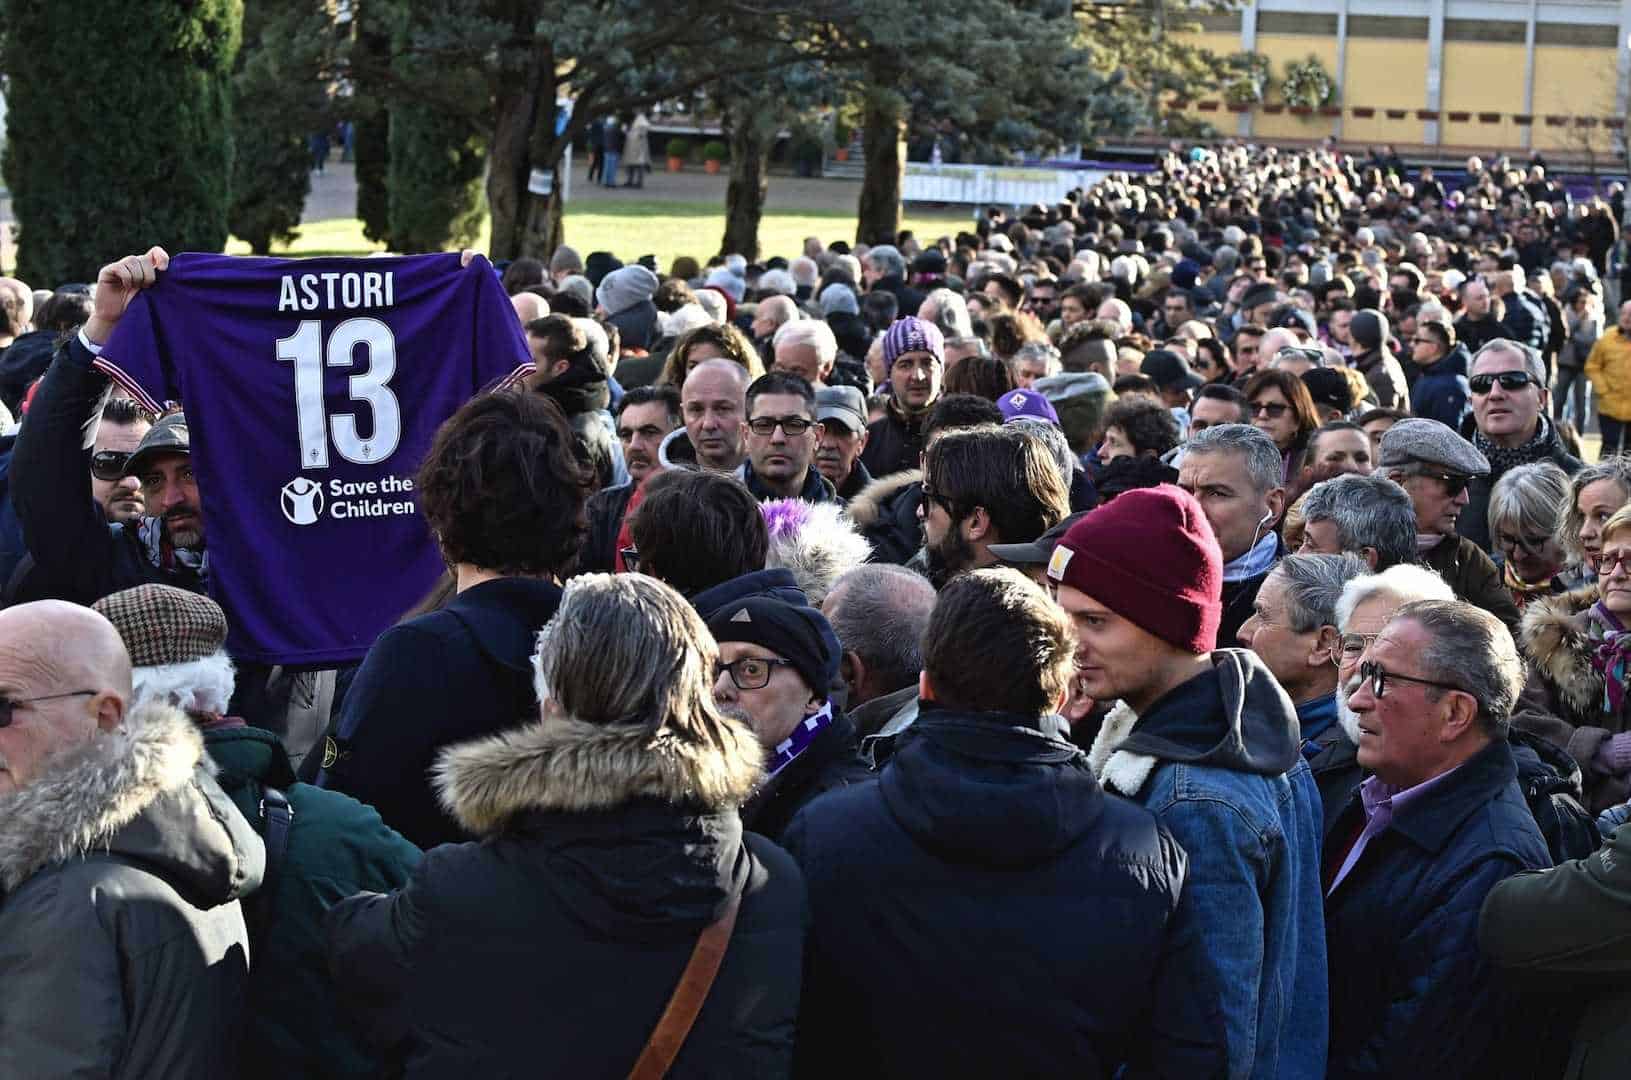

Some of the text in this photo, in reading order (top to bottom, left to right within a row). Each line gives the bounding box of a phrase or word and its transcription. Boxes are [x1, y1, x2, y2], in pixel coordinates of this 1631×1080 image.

[278, 272, 394, 311] ASTORI
[276, 317, 401, 469] 13
[329, 475, 414, 496] Save the
[330, 499, 415, 518] Children
